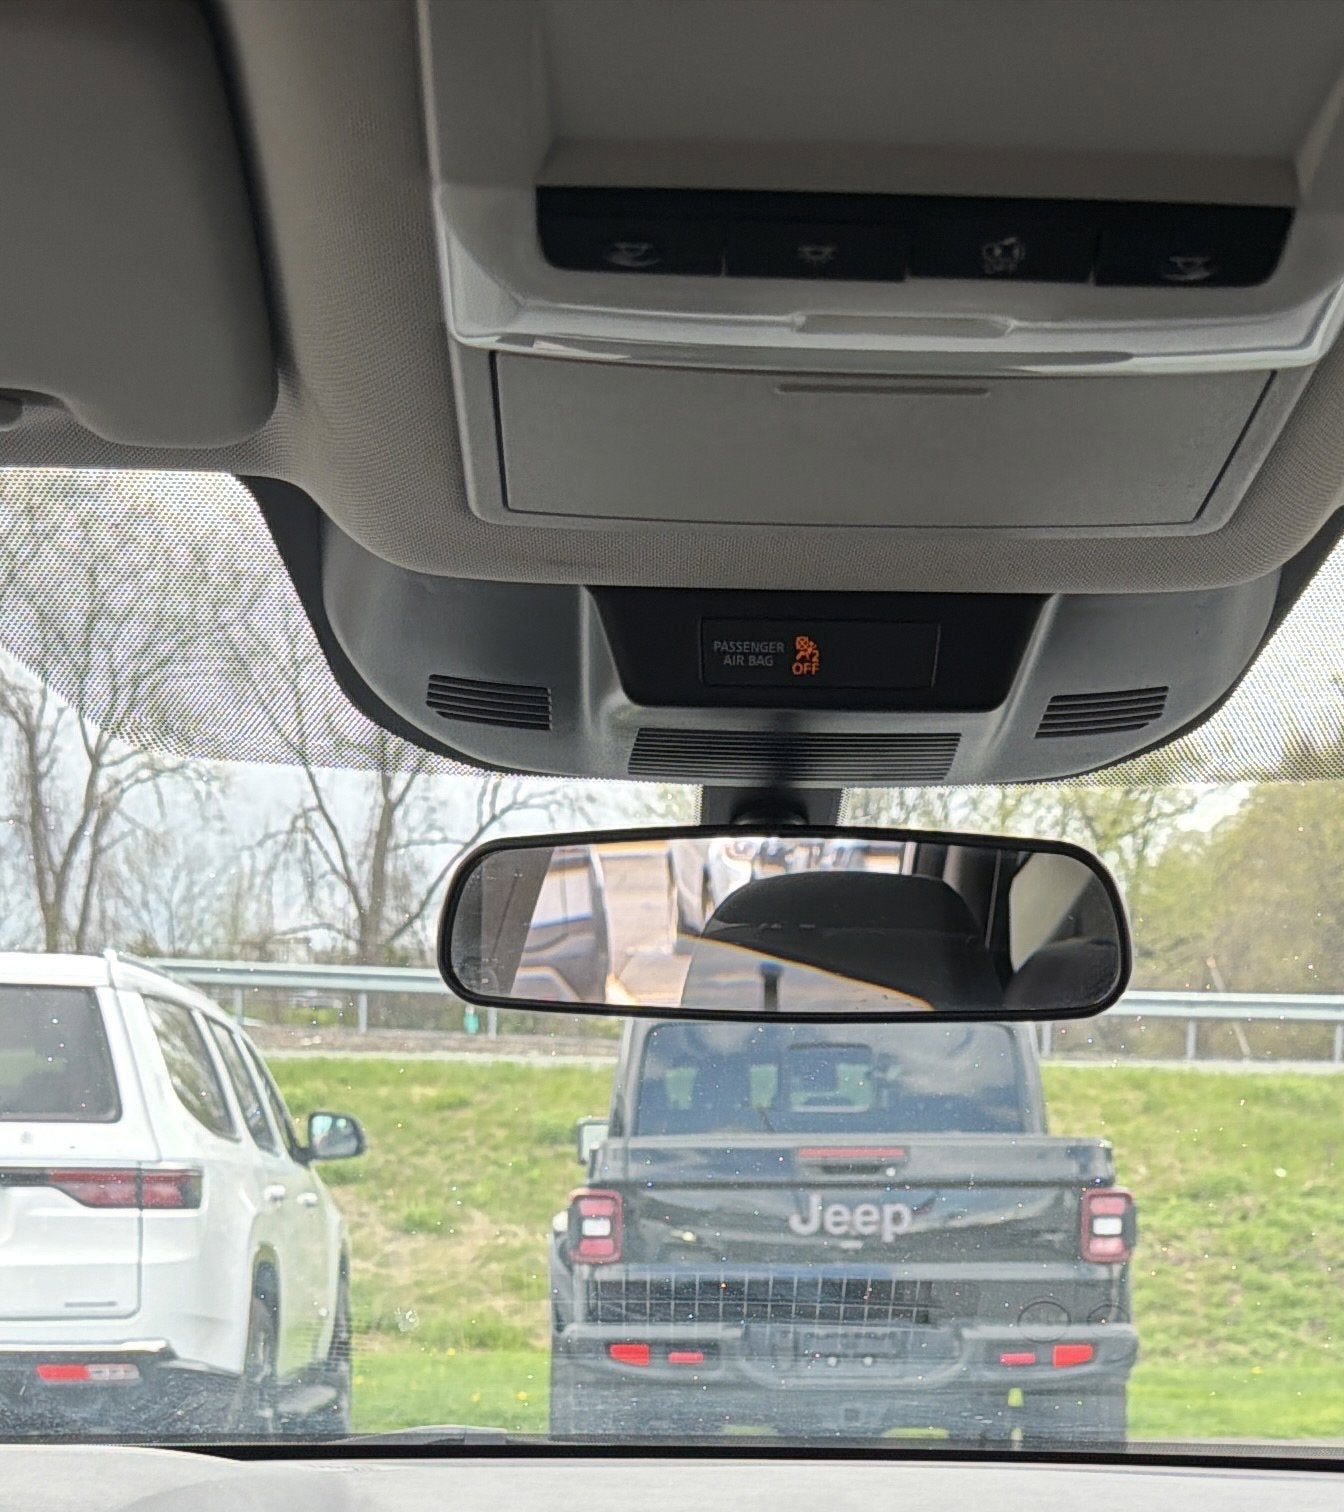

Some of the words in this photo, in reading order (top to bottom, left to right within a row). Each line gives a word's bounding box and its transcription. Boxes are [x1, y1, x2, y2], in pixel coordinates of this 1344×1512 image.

[713, 641, 785, 654] PASSENGER
[722, 654, 746, 667] AIR
[748, 655, 775, 668] BAG
[791, 661, 820, 676] OFF
[788, 1192, 912, 1243] Jeep
